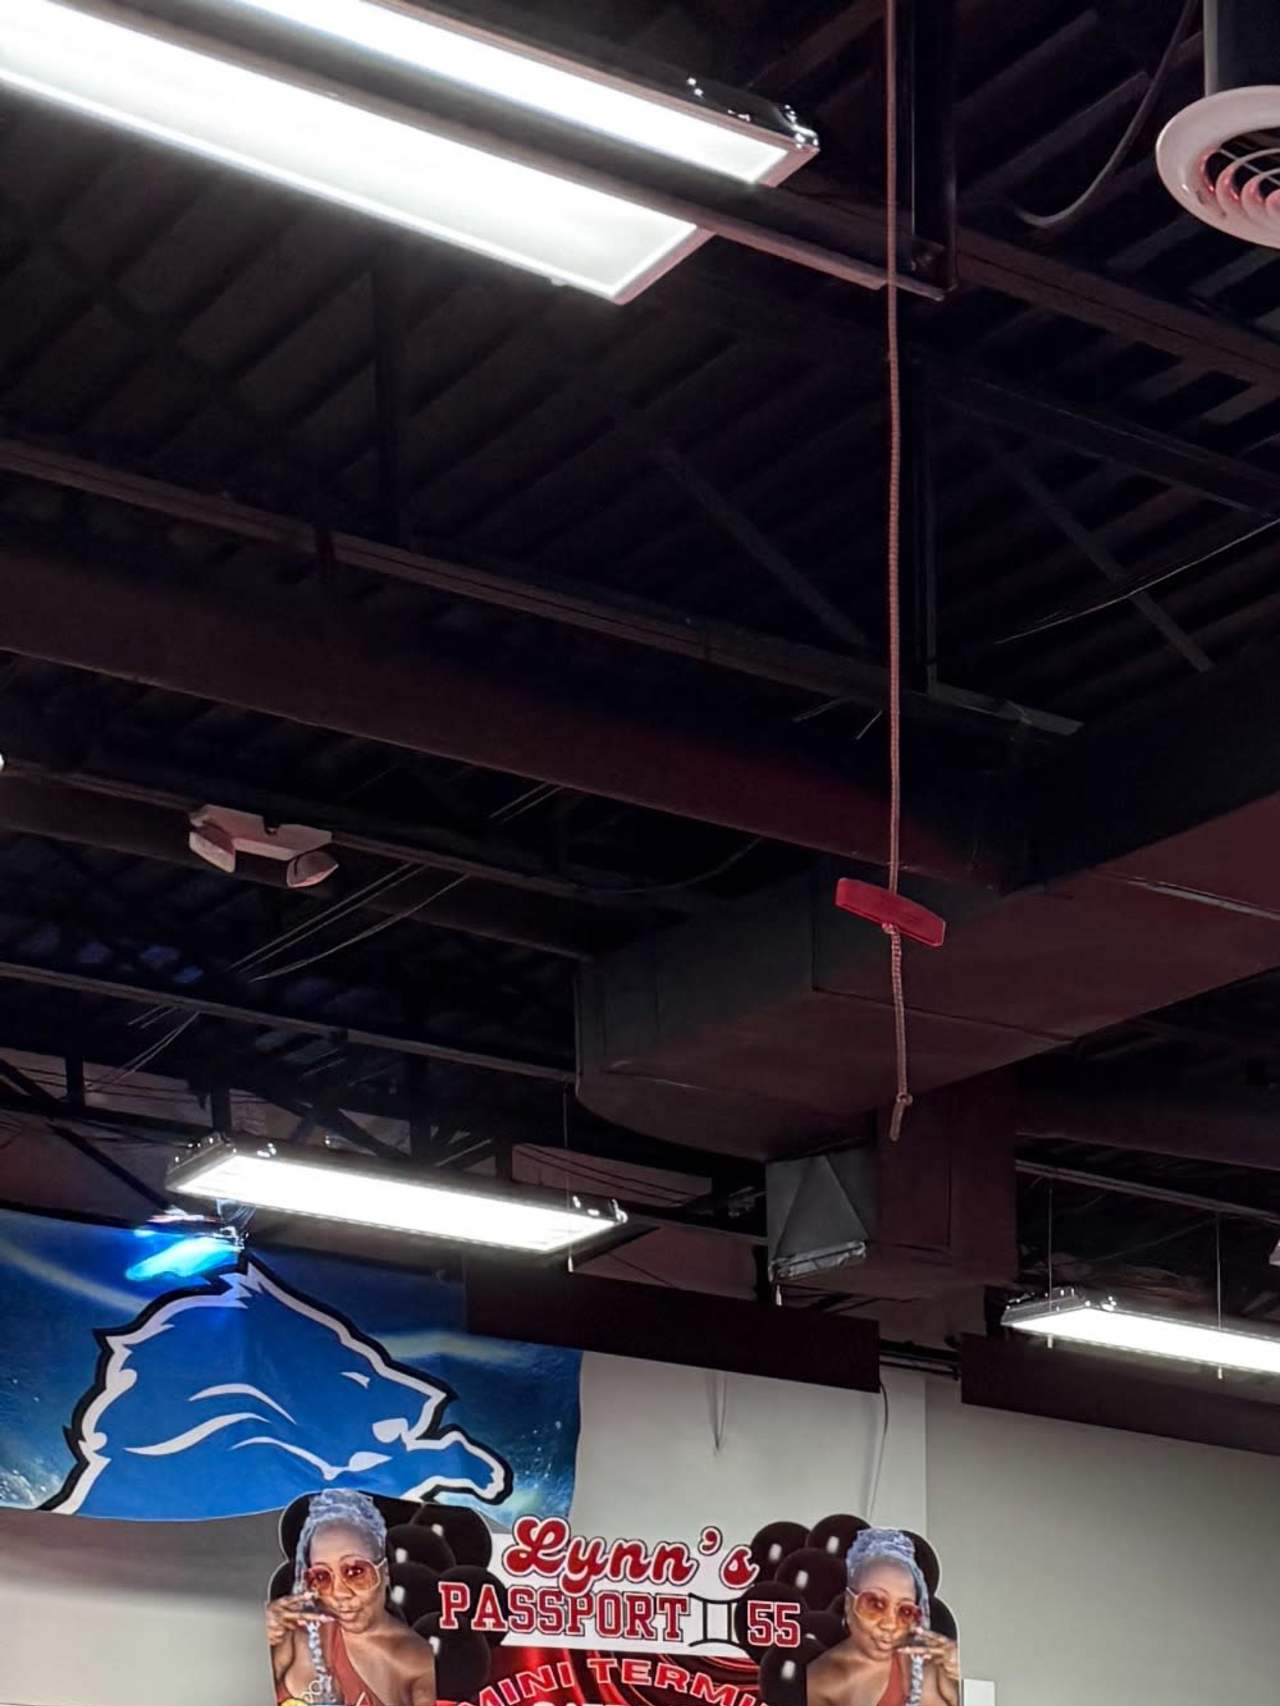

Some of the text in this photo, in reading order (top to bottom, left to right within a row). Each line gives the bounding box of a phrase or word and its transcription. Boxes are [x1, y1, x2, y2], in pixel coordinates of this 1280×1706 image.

[501, 1514, 761, 1596] Lynn's
[437, 1580, 801, 1648] PASSPORT 55
